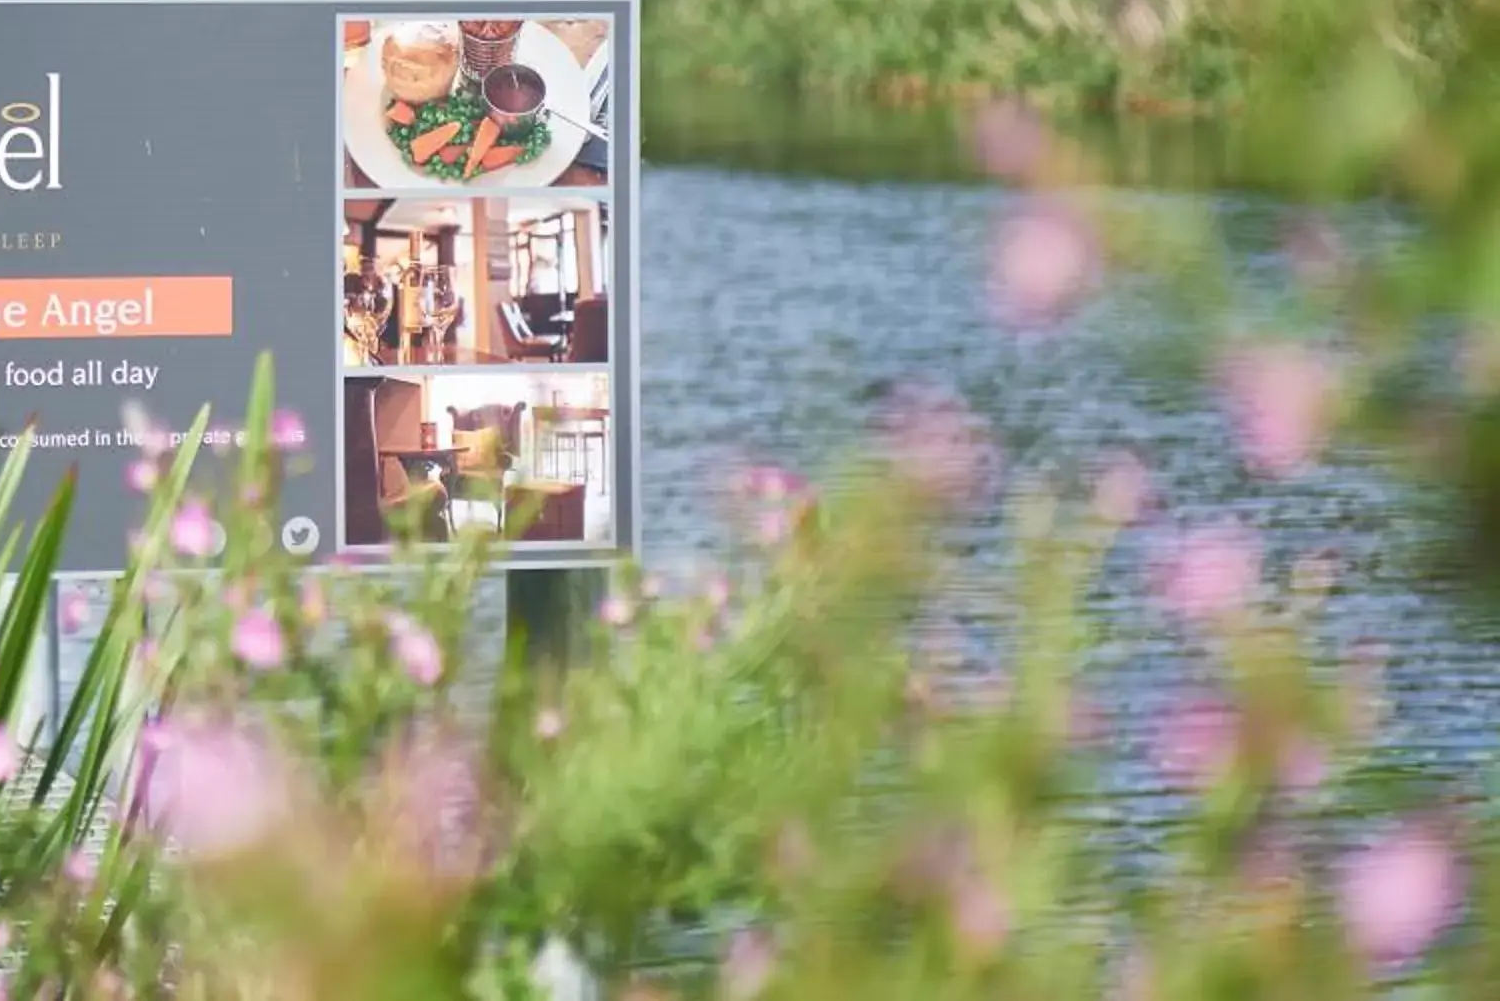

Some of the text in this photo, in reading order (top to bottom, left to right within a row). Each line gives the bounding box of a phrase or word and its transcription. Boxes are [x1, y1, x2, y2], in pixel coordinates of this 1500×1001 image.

[41, 287, 153, 335] Angel
[5, 360, 64, 387] food
[72, 360, 102, 386] all
[111, 359, 159, 390] day
[0, 428, 89, 448] cosumed
[95, 429, 111, 446] in
